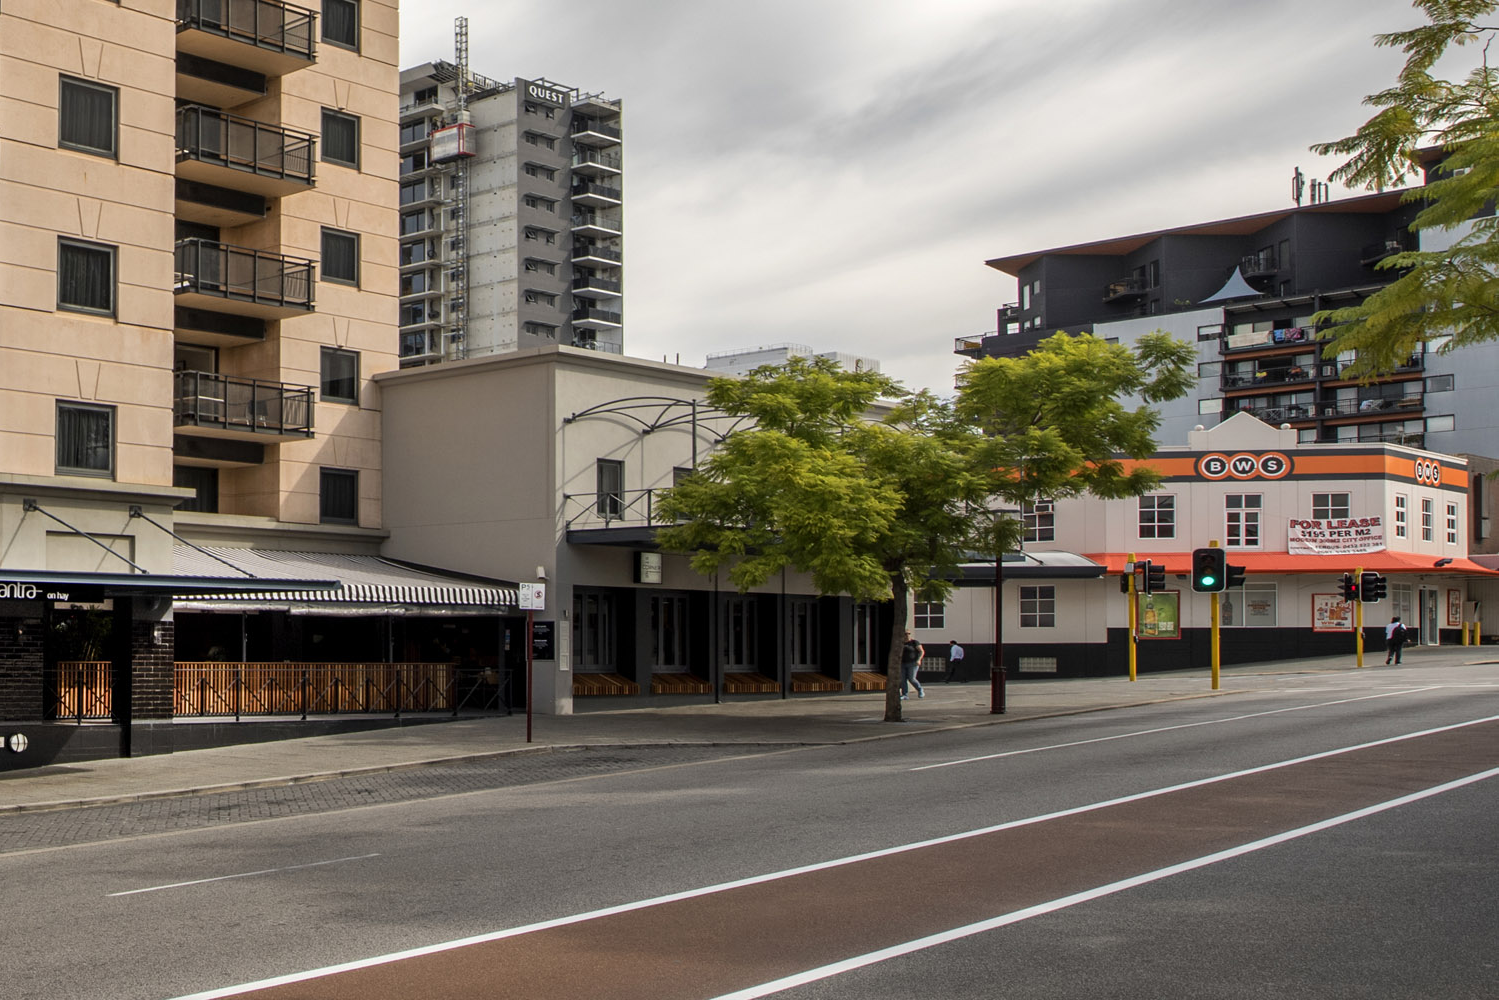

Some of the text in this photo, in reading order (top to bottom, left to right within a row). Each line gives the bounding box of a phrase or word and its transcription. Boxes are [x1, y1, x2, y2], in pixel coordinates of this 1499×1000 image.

[529, 85, 564, 104] QUEST
[1290, 517, 1381, 530] FOR LEASE
[1329, 530, 1352, 538] PER
[1355, 528, 1372, 537] M2
[46, 592, 56, 600] on
[57, 591, 70, 601] hay
